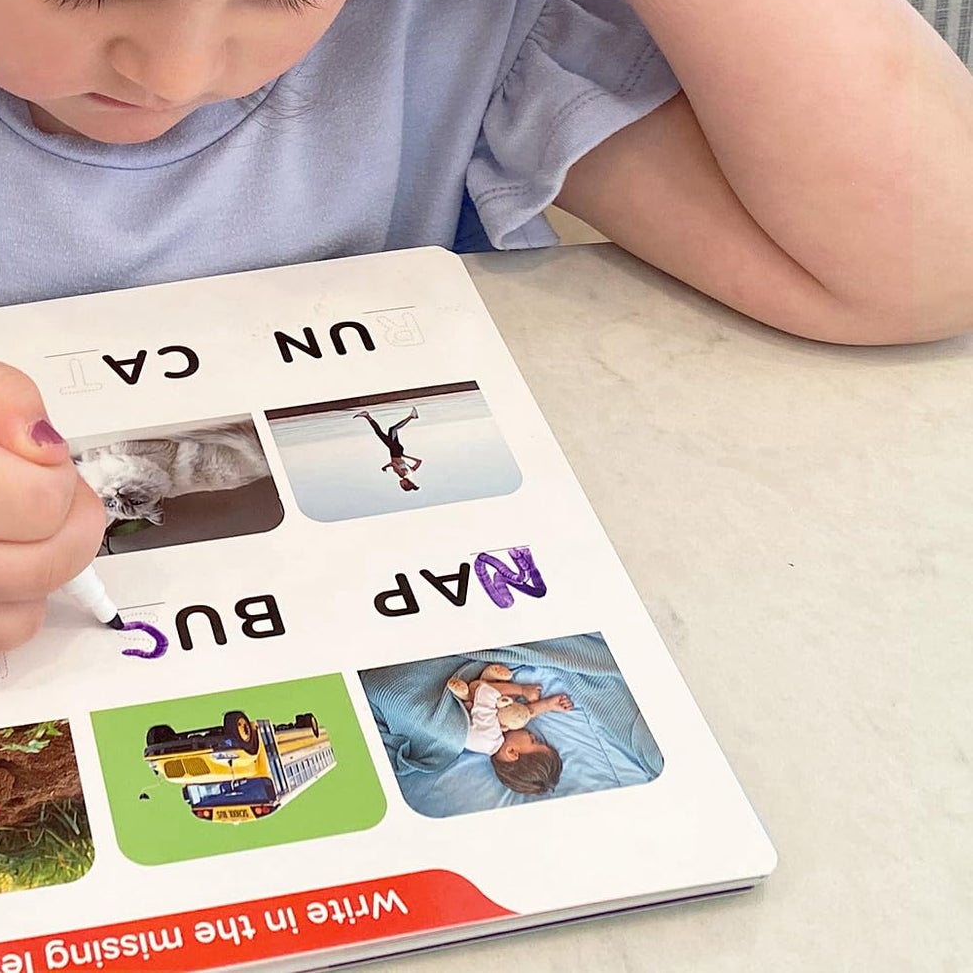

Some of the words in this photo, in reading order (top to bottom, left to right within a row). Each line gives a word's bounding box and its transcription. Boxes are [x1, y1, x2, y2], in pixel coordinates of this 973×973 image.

[373, 546, 547, 618] NAP
[265, 907, 298, 934] in
[306, 888, 409, 924] Write
[43, 927, 183, 971] missing
[194, 916, 257, 946] the
